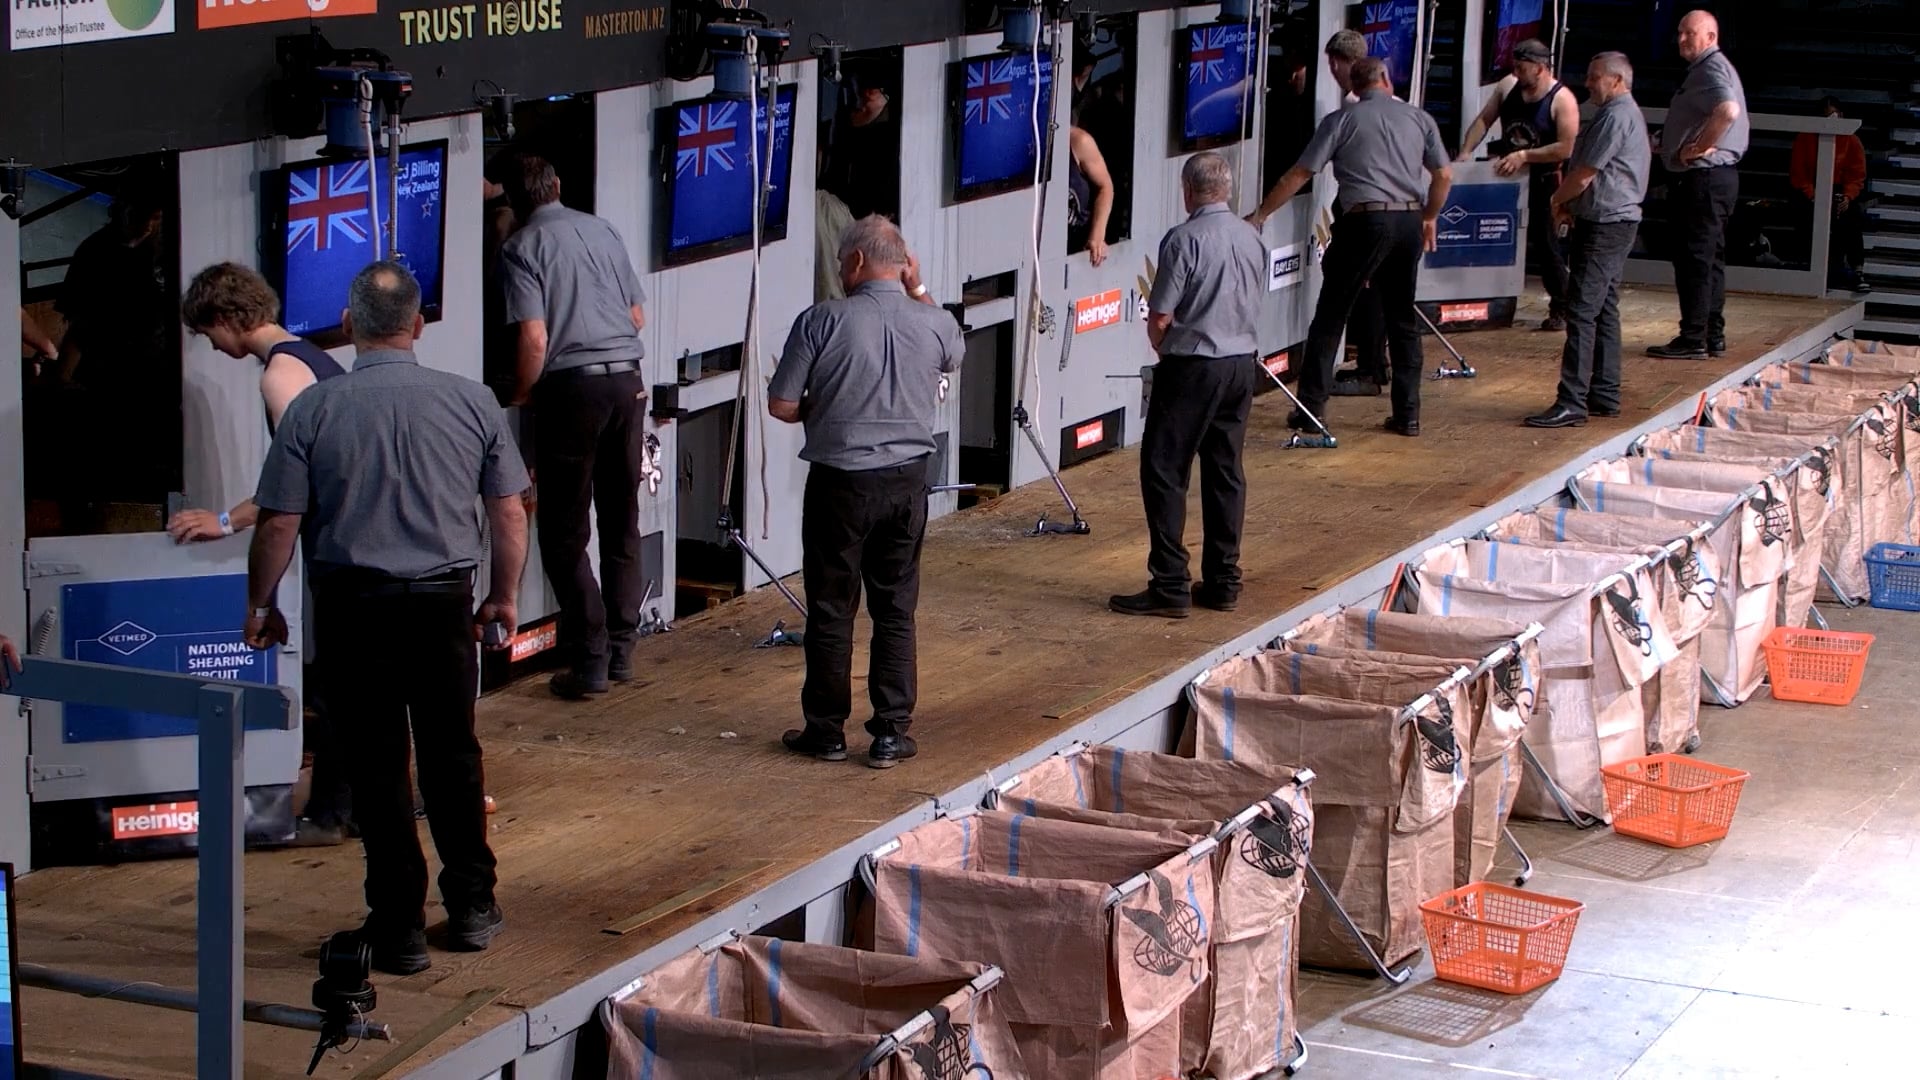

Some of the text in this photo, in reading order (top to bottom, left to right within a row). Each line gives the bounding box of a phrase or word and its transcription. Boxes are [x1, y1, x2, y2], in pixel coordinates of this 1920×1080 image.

[15, 29, 35, 40] Office
[37, 26, 44, 37] of
[45, 25, 57, 36] the
[79, 22, 105, 33] Trustee
[400, 0, 563, 46] TRUST HOUSE
[585, 7, 665, 39] MASTERTON.NZ
[411, 160, 440, 178] Billing
[411, 178, 440, 194] Zealand
[1078, 293, 1120, 327] Heiniger
[108, 633, 148, 643] VETMED
[188, 642, 254, 656] NATIONAL
[188, 655, 254, 669] SHEARING
[118, 802, 199, 832] Heinig
